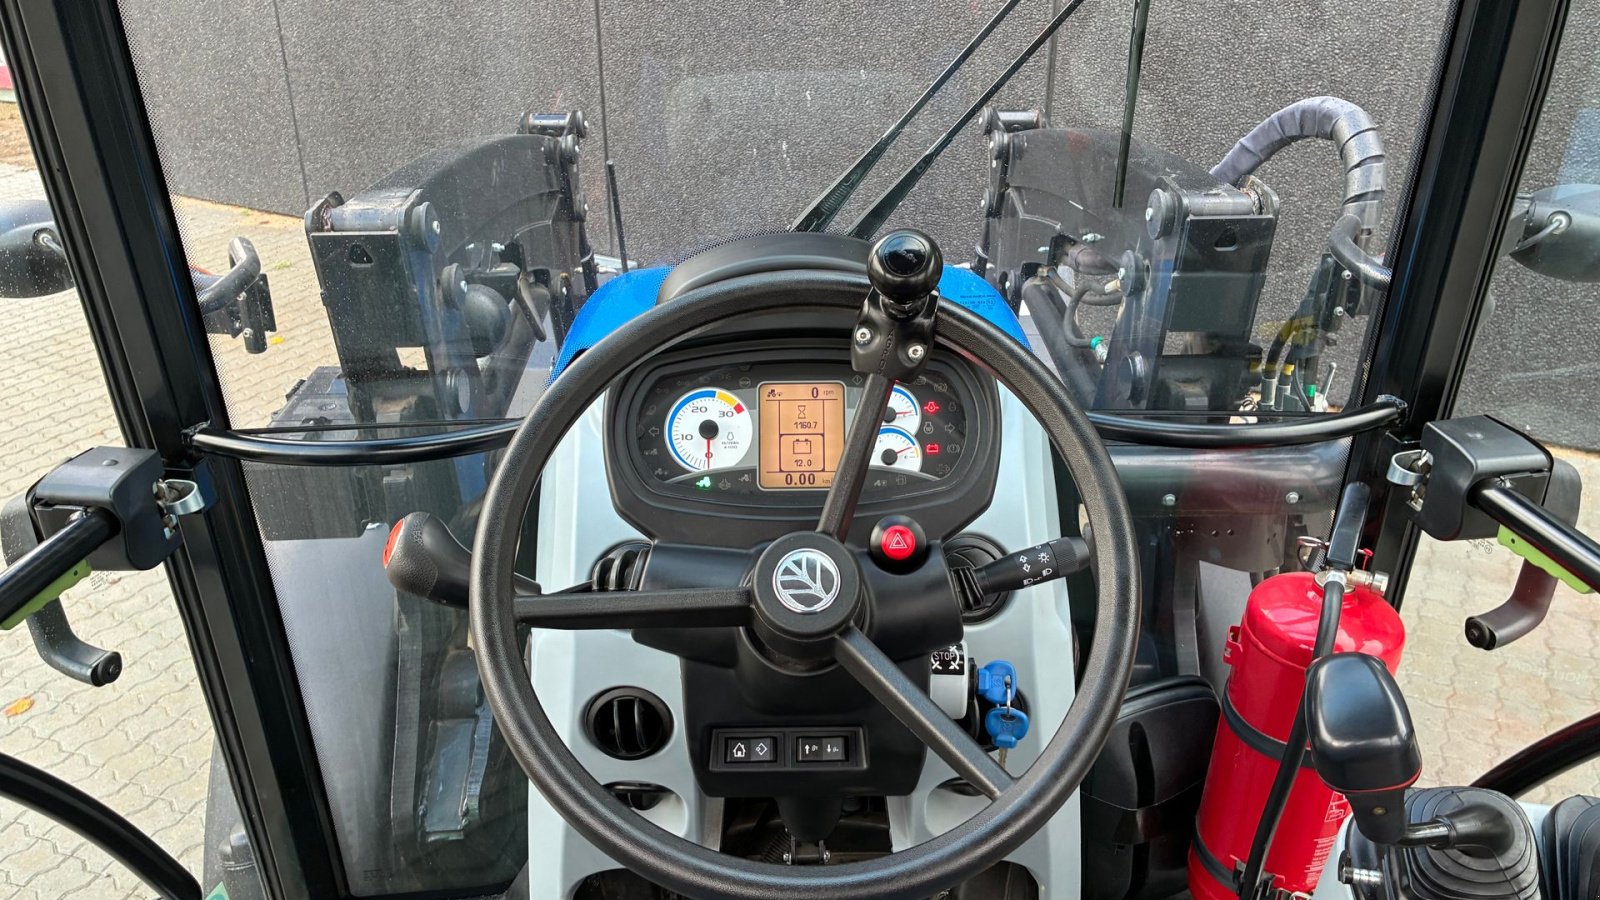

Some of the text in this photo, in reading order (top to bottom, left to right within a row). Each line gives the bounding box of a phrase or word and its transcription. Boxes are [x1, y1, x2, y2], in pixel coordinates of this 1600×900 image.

[811, 387, 819, 398] 0
[691, 405, 708, 413] 20
[718, 410, 734, 418] 30
[793, 421, 818, 429] 1160.7
[681, 433, 694, 441] 10
[794, 459, 812, 467] 12.0
[785, 473, 816, 486] 0.00
[933, 651, 955, 660] STOP
